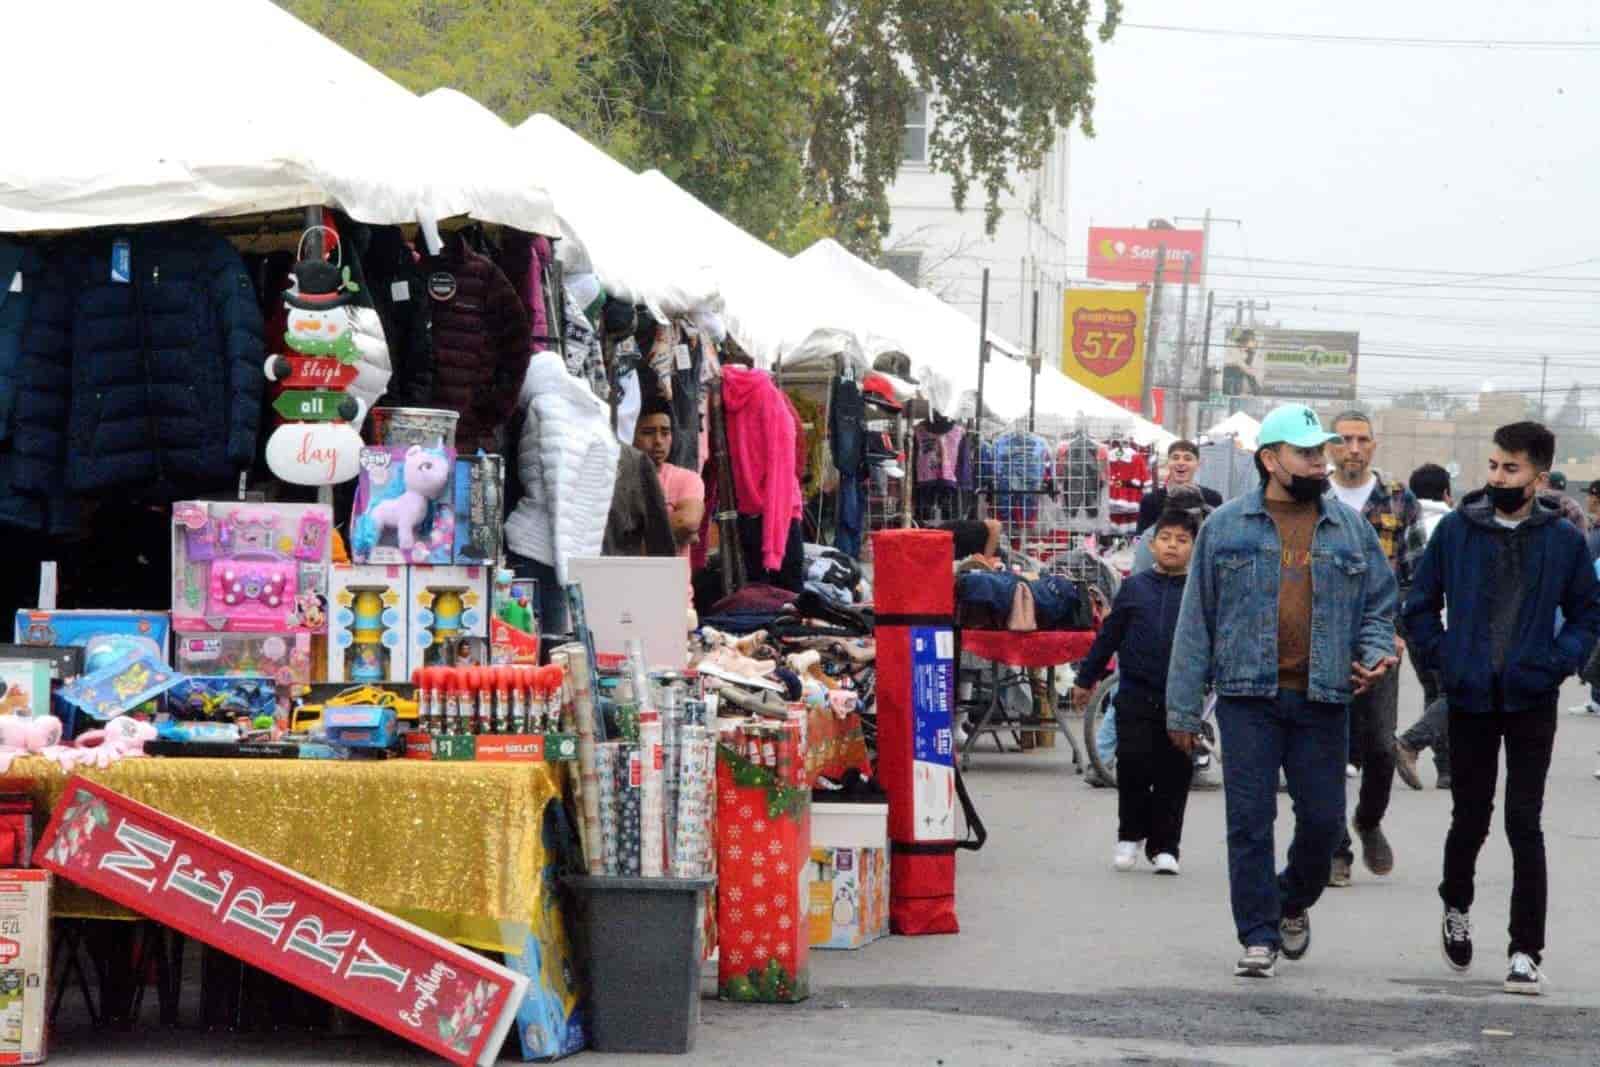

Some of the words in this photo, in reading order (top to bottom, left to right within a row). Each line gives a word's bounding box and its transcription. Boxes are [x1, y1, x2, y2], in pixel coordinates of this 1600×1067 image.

[1129, 244, 1193, 260] Sorna
[1081, 331, 1128, 360] 57
[301, 362, 342, 382] Sleigh
[300, 398, 323, 414] all
[296, 432, 337, 480] day
[98, 817, 411, 993] MERRY
[398, 961, 456, 1027] Everything
